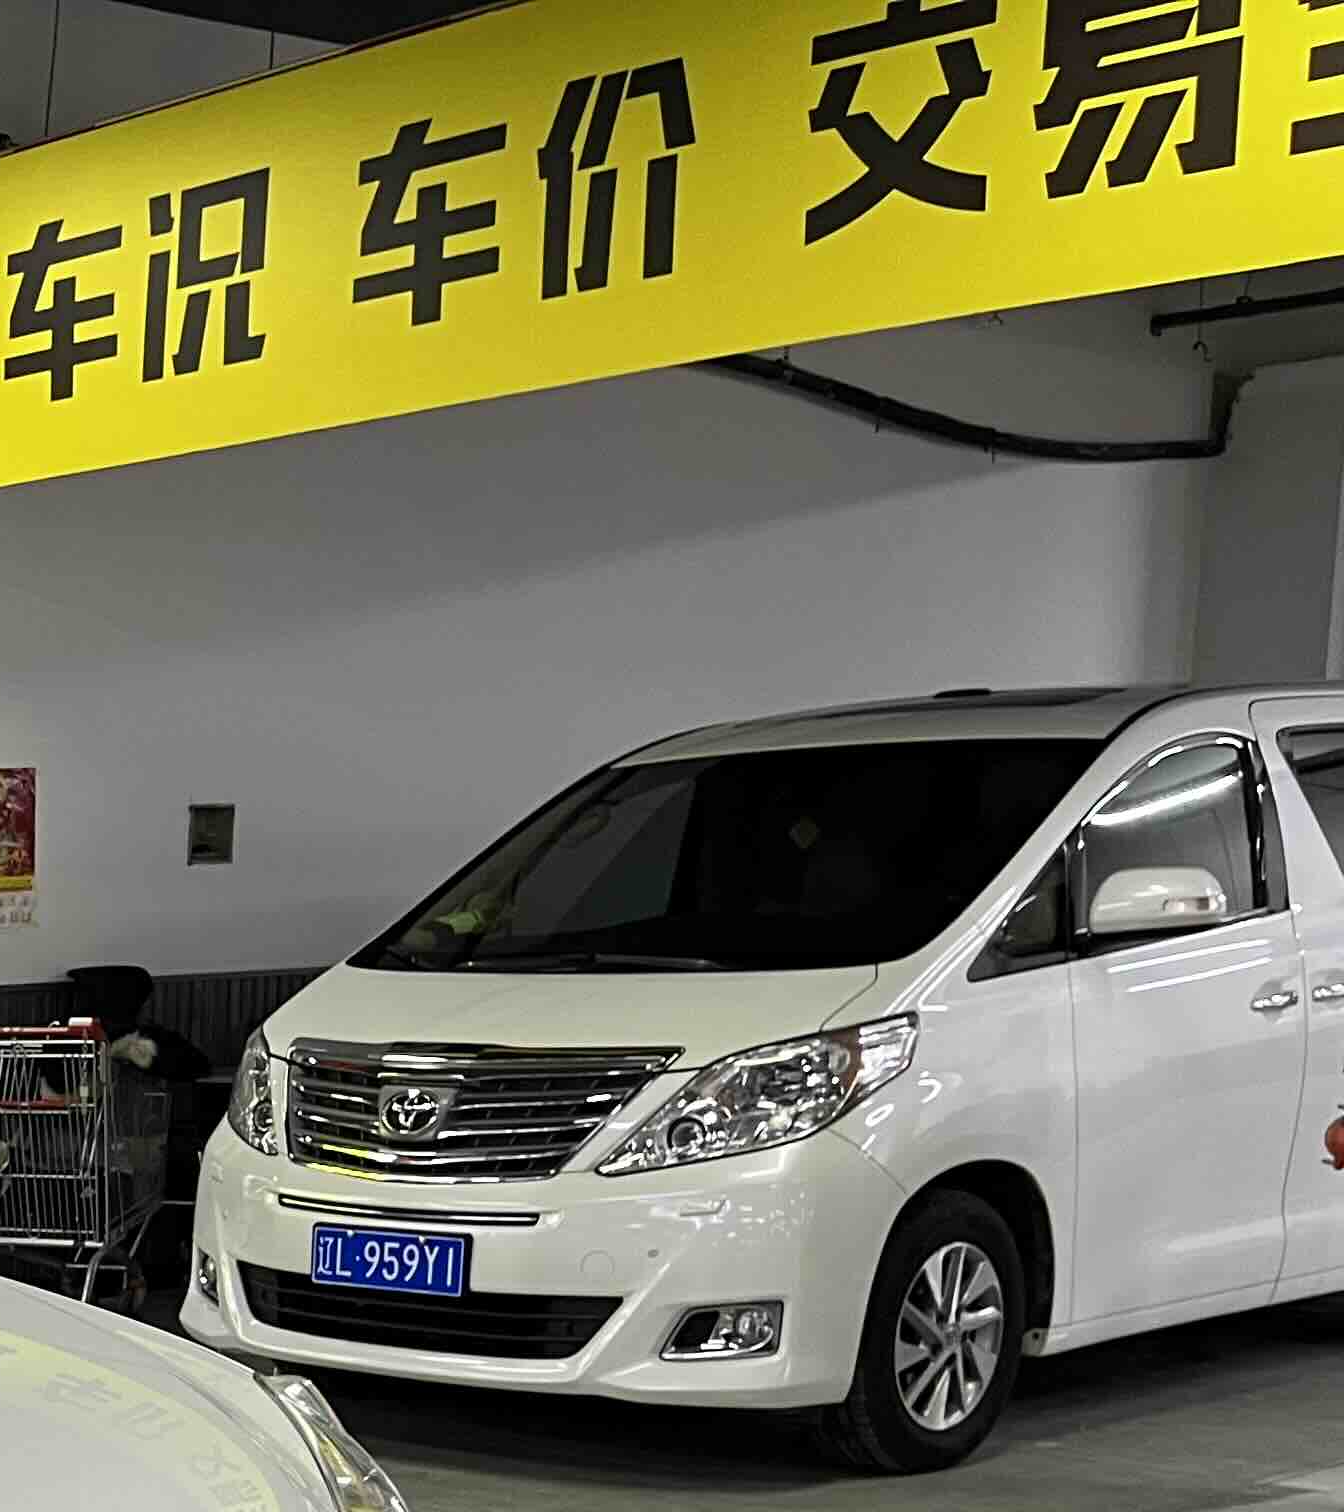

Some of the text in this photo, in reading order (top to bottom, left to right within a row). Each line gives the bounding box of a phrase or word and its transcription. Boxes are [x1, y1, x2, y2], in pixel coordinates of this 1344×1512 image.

[3, 0, 1344, 401] 车况 车价 交易
